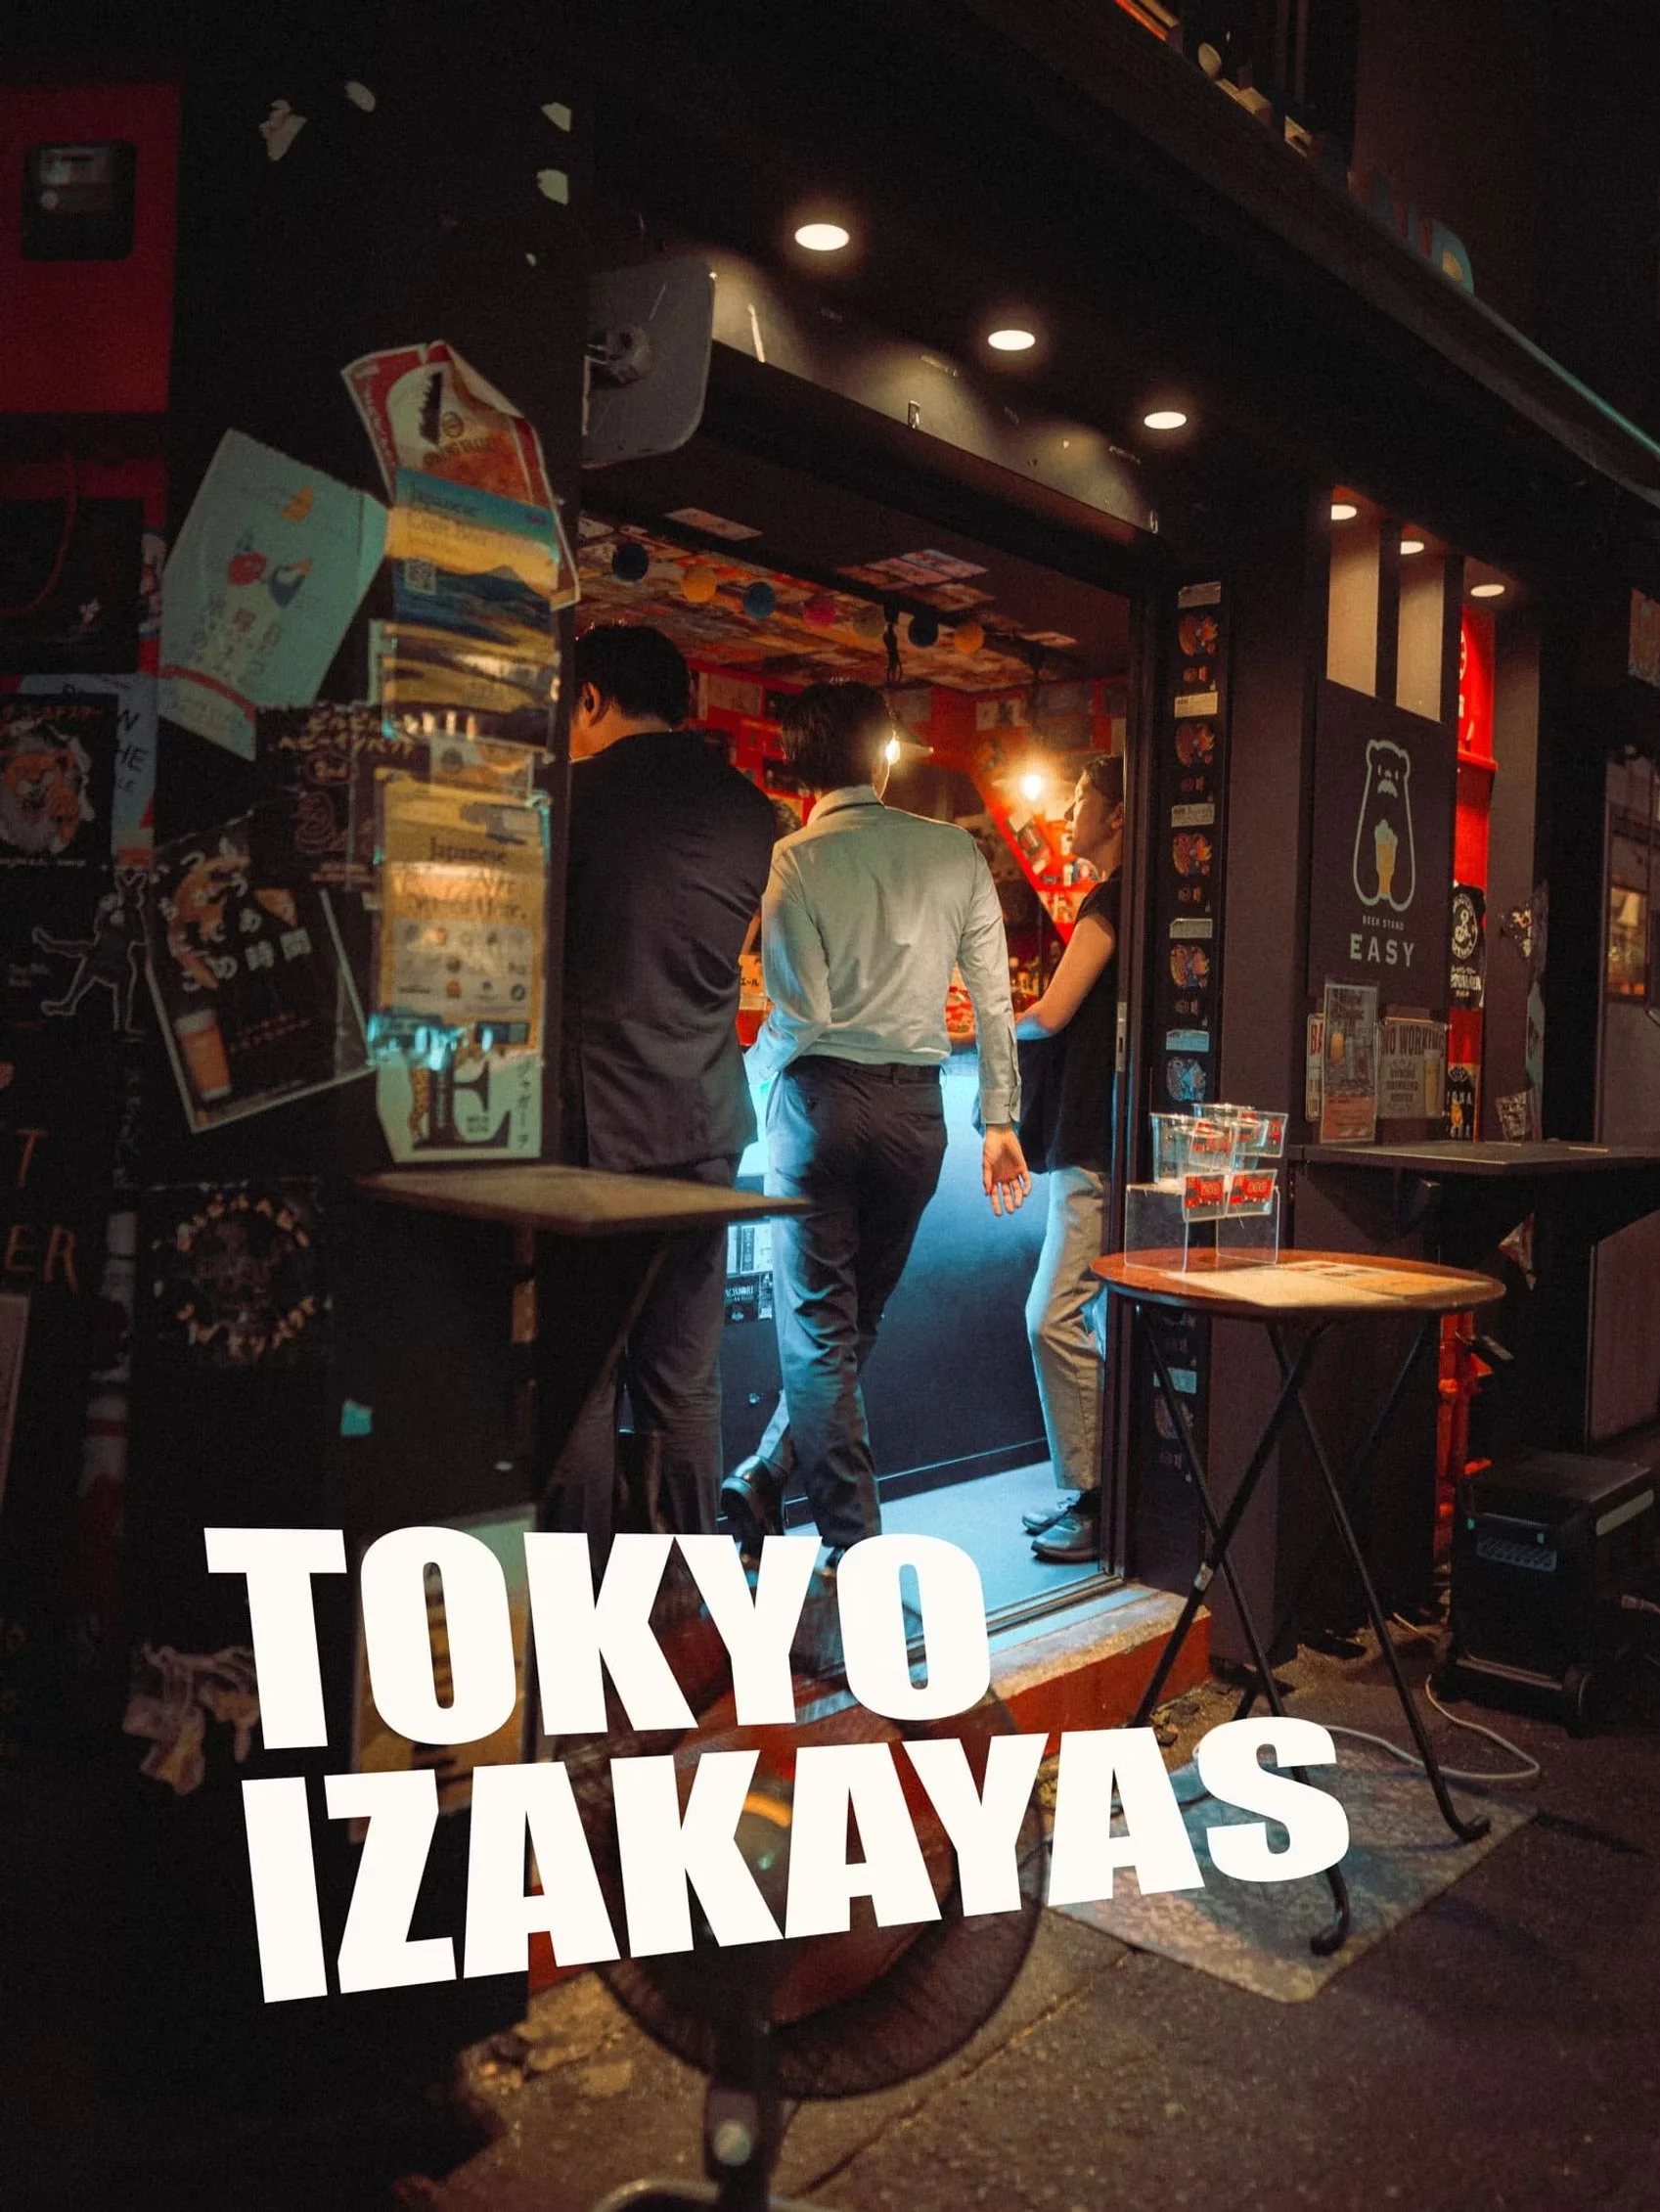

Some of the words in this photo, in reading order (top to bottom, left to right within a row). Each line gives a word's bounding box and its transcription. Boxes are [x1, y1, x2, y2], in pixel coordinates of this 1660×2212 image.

[1362, 915, 1380, 927] BEER
[1382, 918, 1405, 931] STAND
[1350, 932, 1415, 968] EASY
[1399, 1024, 1446, 1061] WORKING
